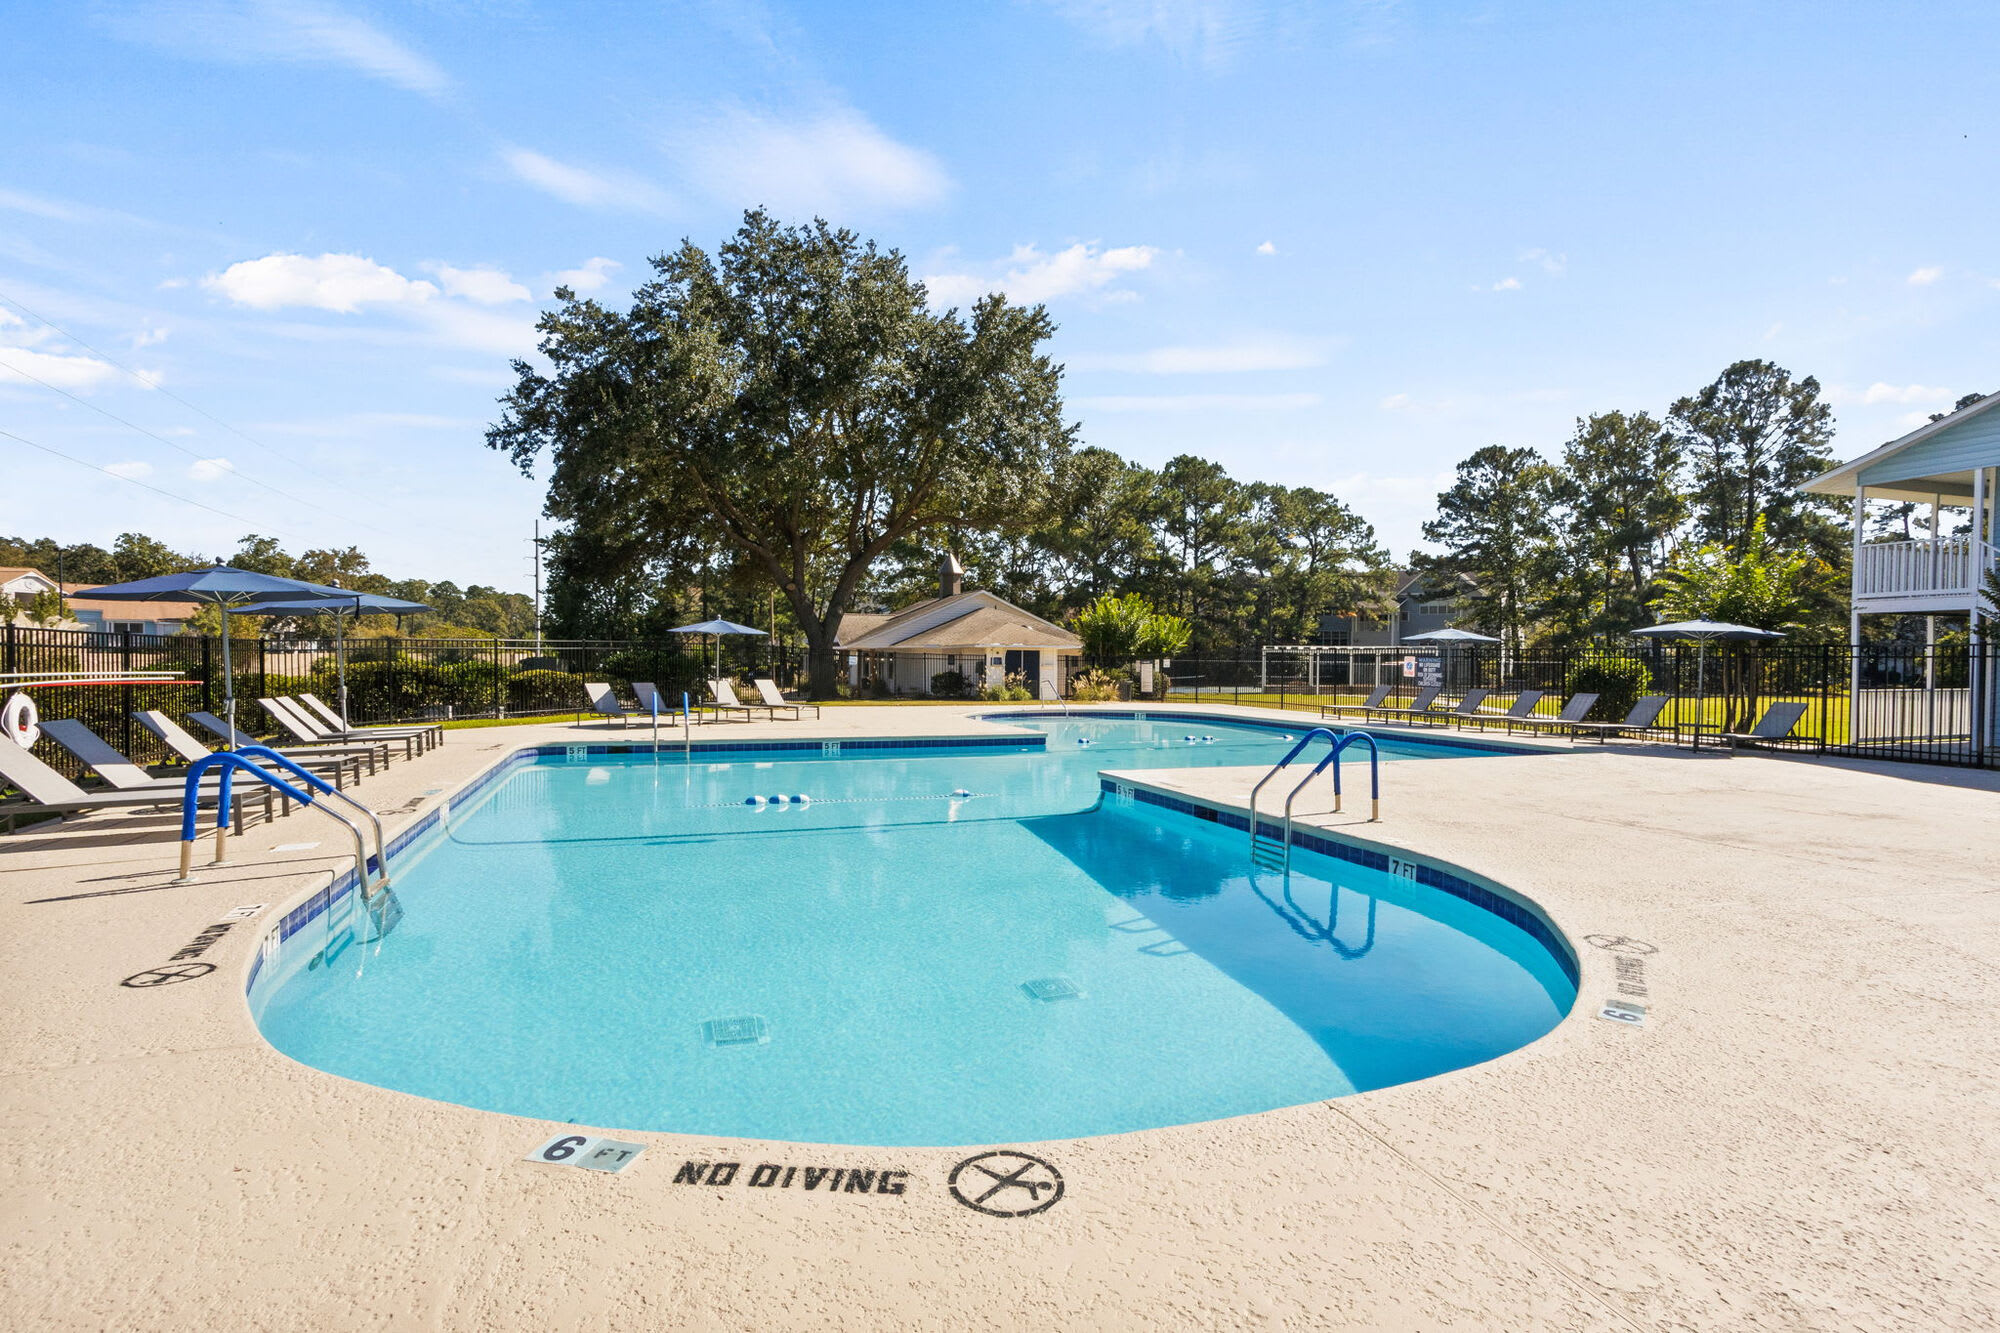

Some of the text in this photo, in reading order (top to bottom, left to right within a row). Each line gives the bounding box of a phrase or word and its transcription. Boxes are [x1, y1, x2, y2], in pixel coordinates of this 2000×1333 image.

[569, 746, 585, 754] 5 FT
[1392, 859, 1415, 880] 7 FT
[1603, 1009, 1642, 1021] 6
[543, 1135, 633, 1163] 6 FT
[673, 1160, 911, 1195] NO DIVING
